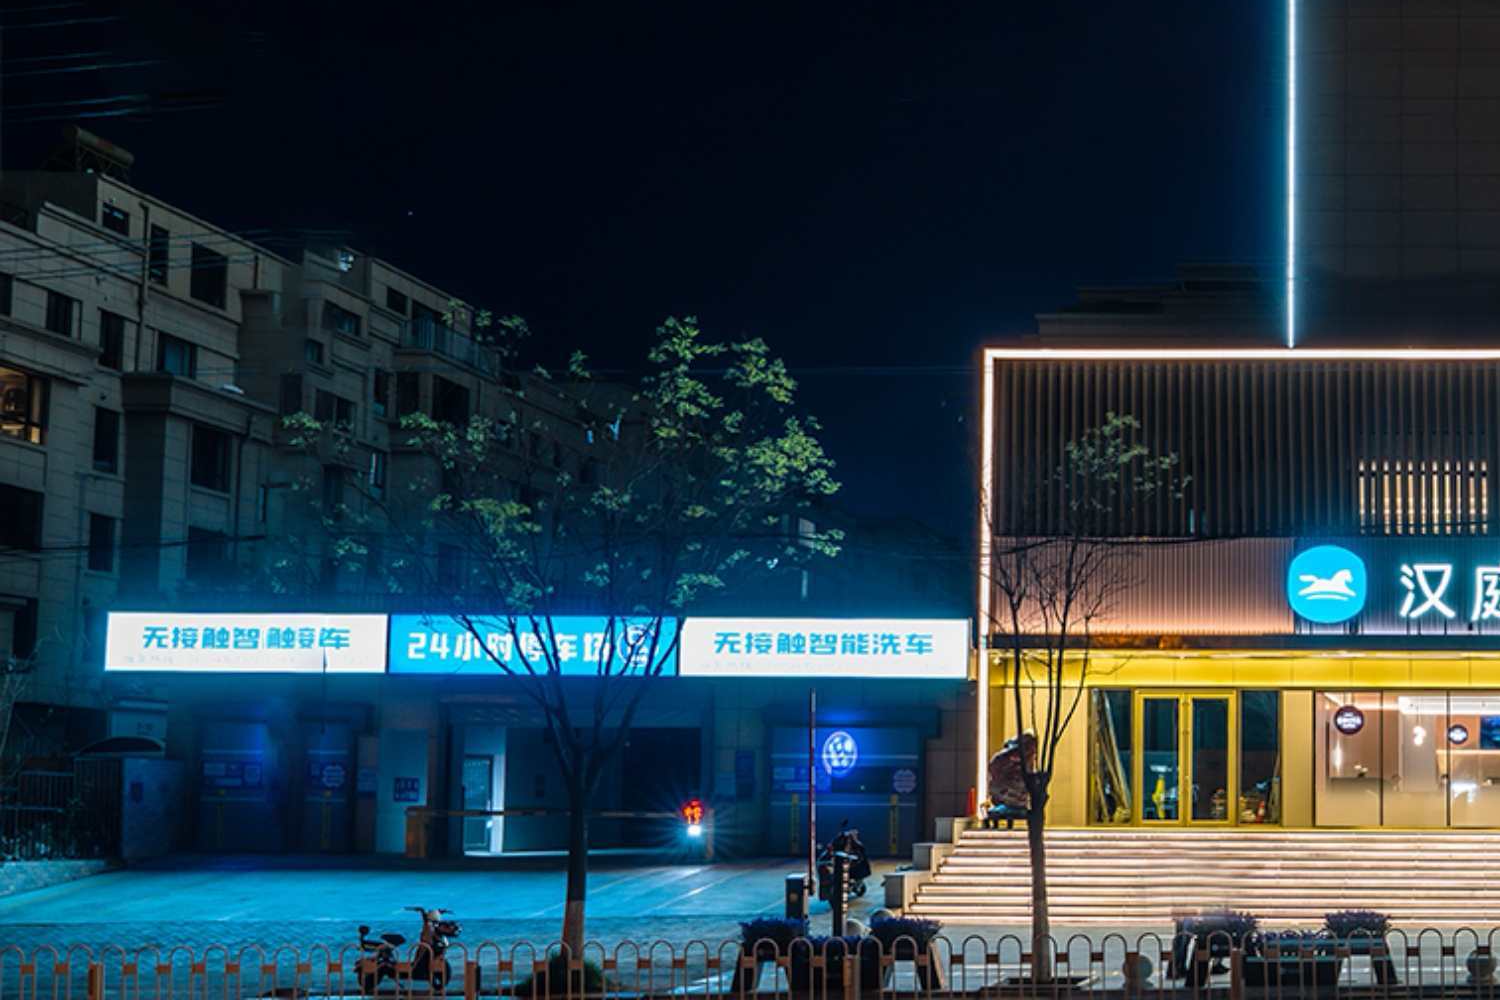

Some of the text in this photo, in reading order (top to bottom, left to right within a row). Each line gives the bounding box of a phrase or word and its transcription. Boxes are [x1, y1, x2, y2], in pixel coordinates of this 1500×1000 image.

[714, 631, 934, 656] 无接触智能洗车
